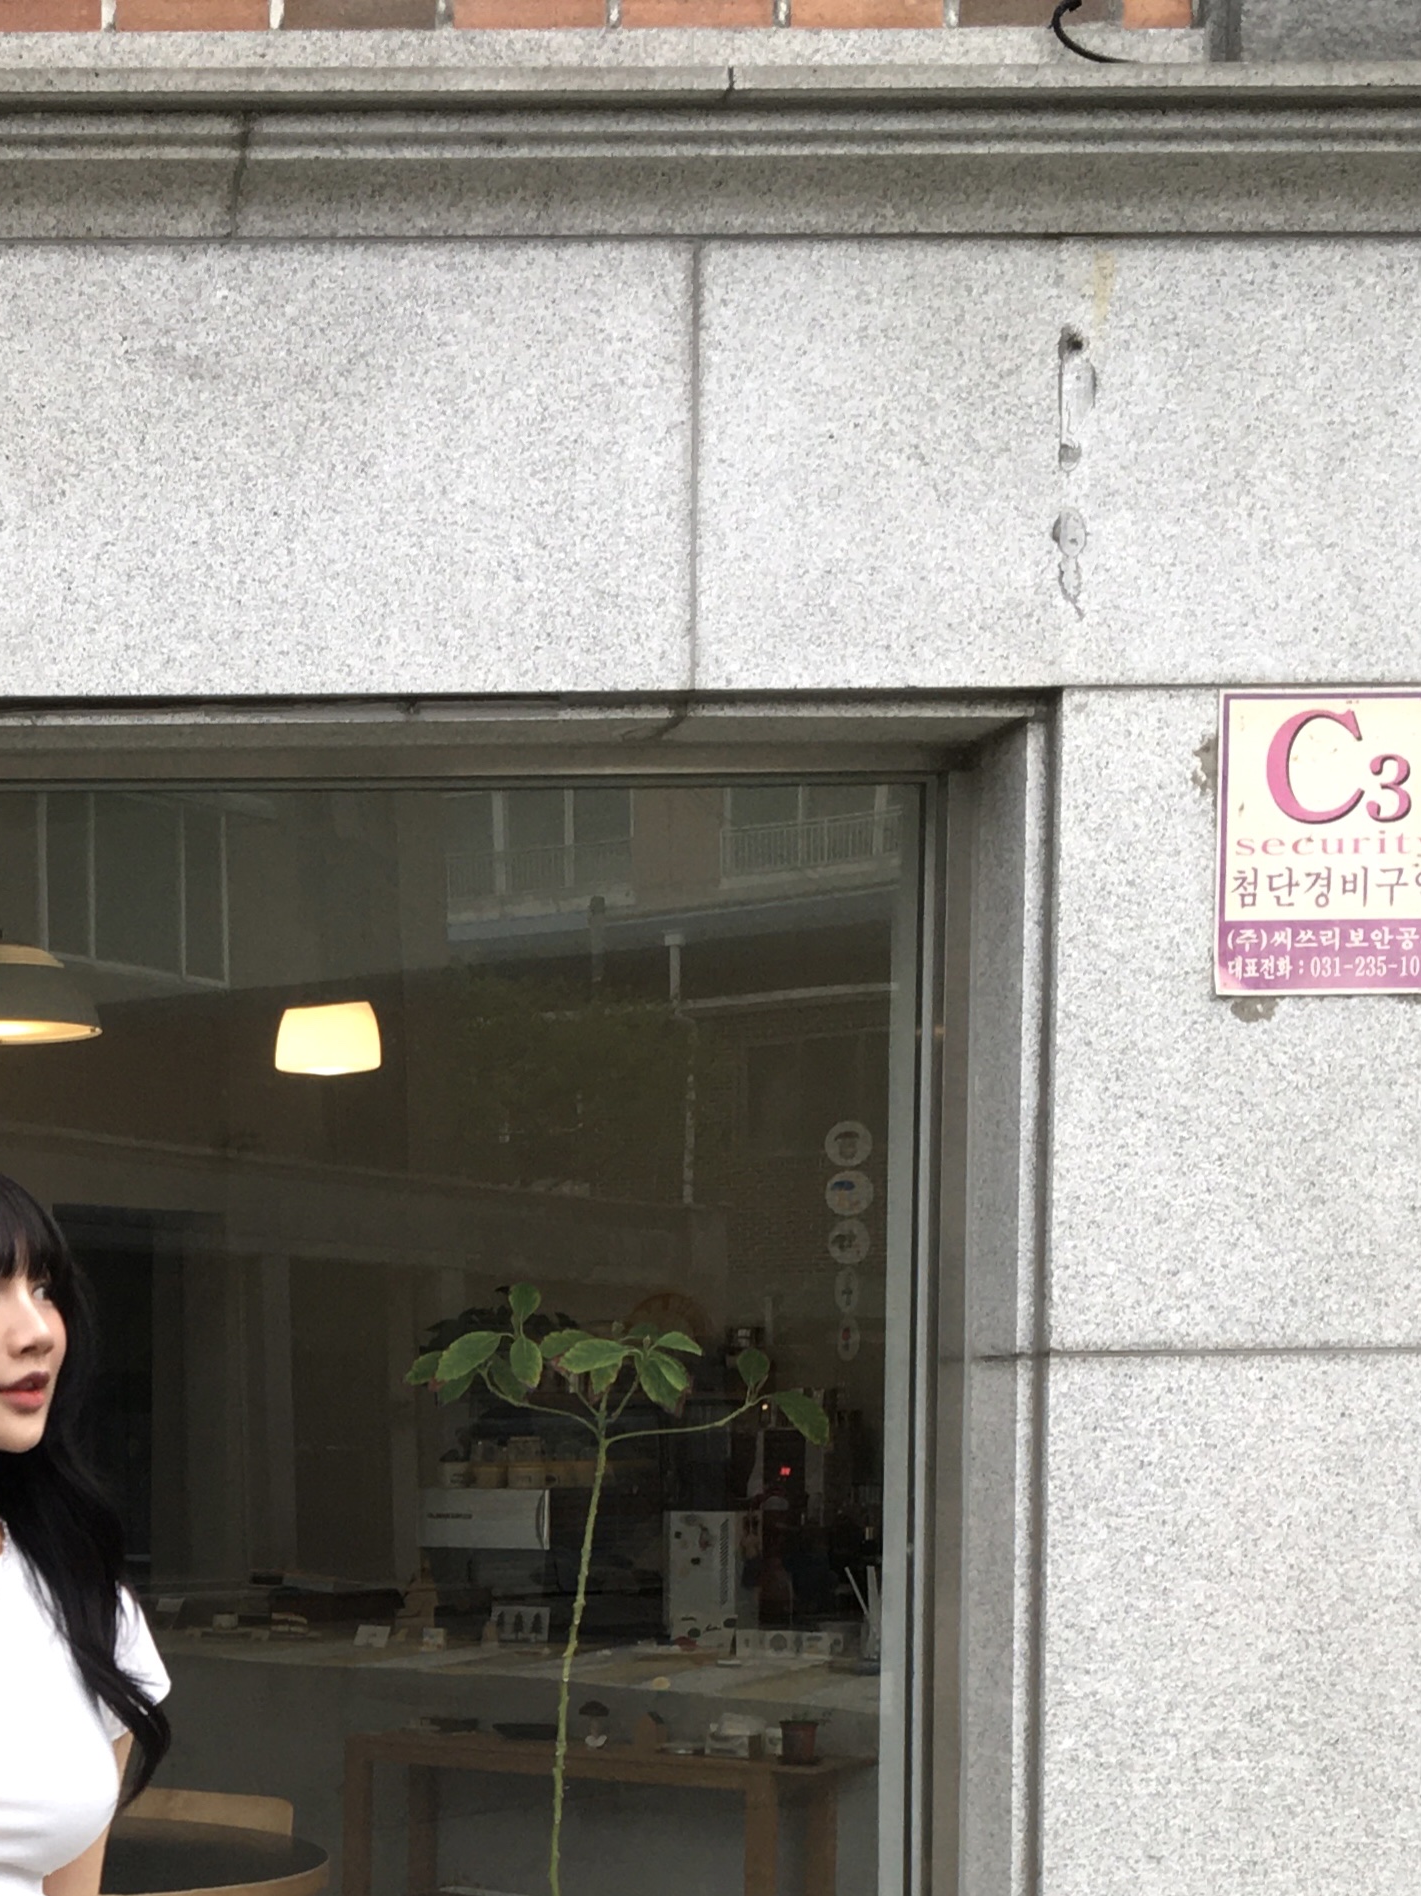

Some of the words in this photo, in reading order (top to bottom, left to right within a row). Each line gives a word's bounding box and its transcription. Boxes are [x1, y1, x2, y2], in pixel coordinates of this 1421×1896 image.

[1266, 708, 1412, 825] C3
[1235, 829, 1421, 858] securit
[1227, 927, 1341, 952] (주)씨쓰리
[1345, 926, 1421, 951] 보안공
[1228, 954, 1293, 981] 대표전화
